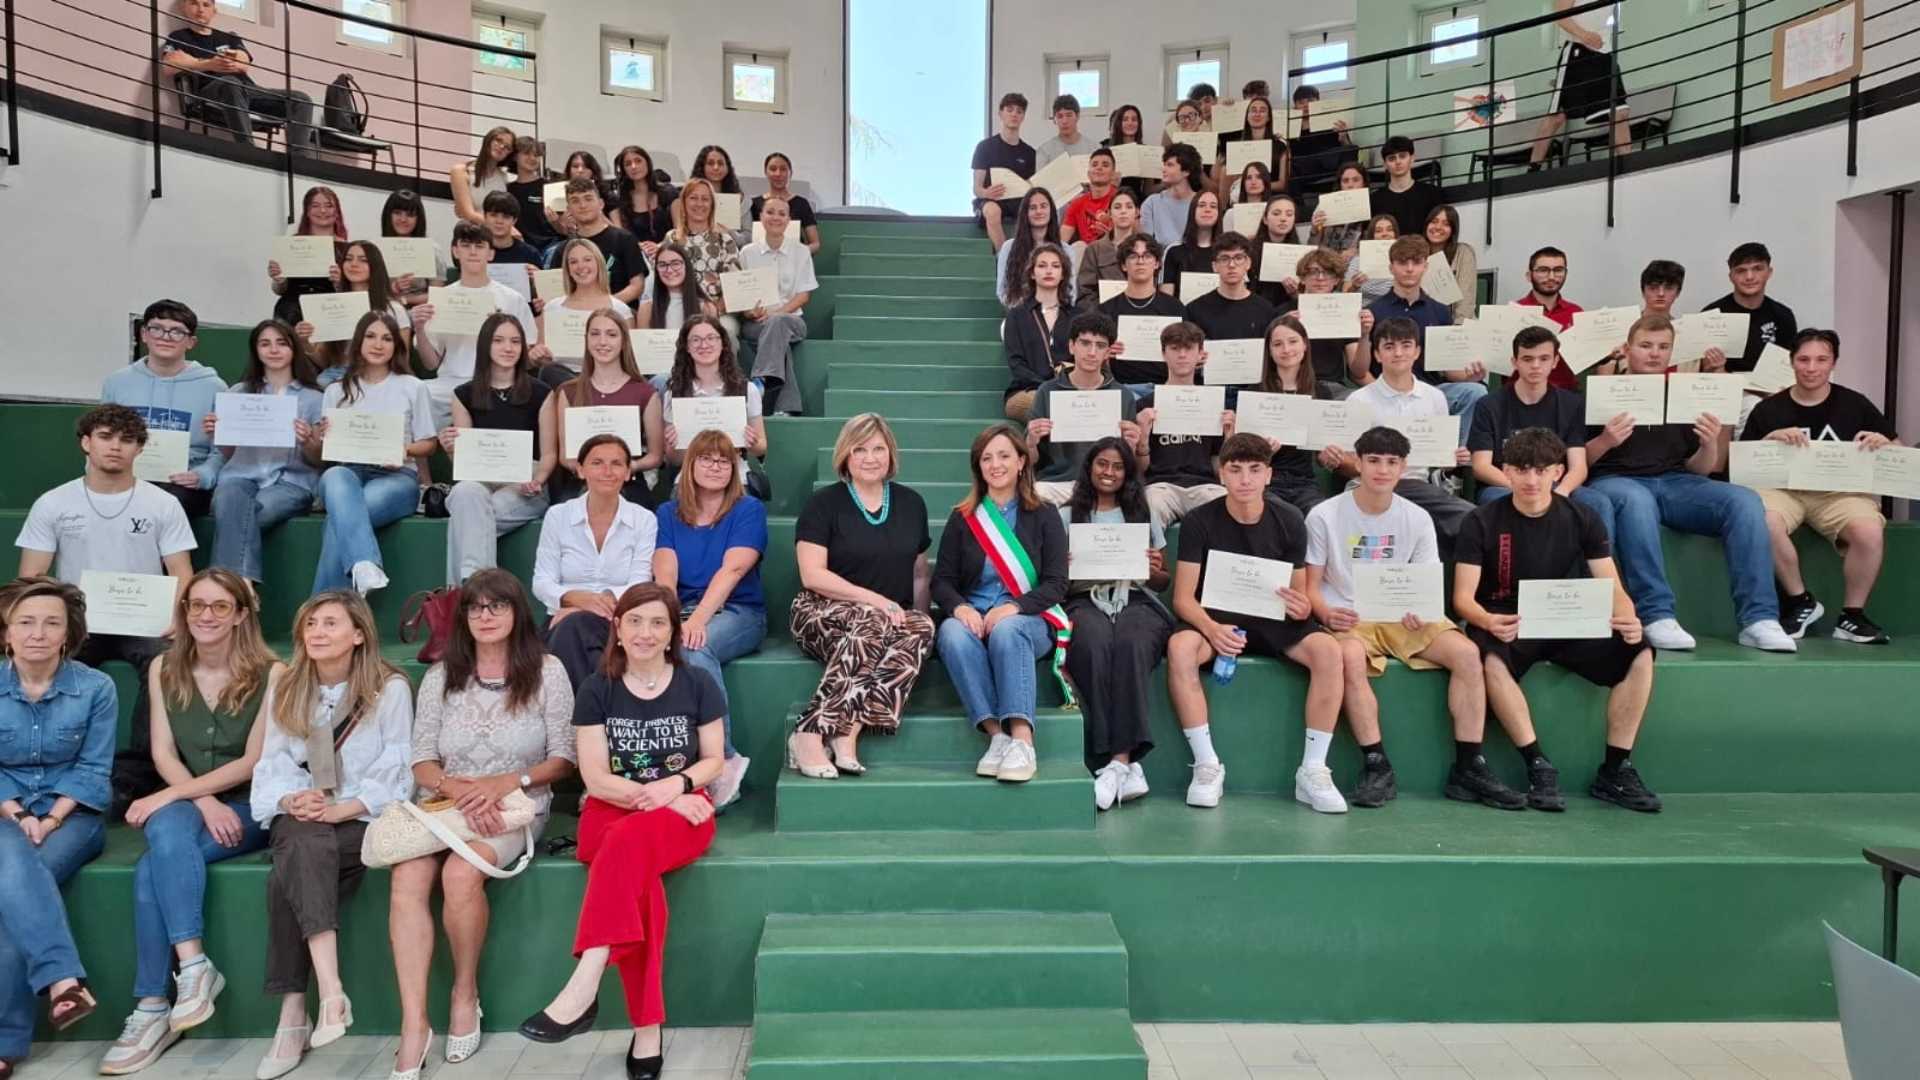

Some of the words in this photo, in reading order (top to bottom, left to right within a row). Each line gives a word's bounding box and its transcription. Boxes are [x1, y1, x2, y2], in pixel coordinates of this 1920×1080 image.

[606, 717, 642, 728] FORGET
[645, 716, 688, 727] PRINCESS
[613, 727, 648, 738] WANT
[654, 726, 671, 737] TO
[674, 725, 688, 735] BE
[617, 735, 689, 752] SCIENTIST
